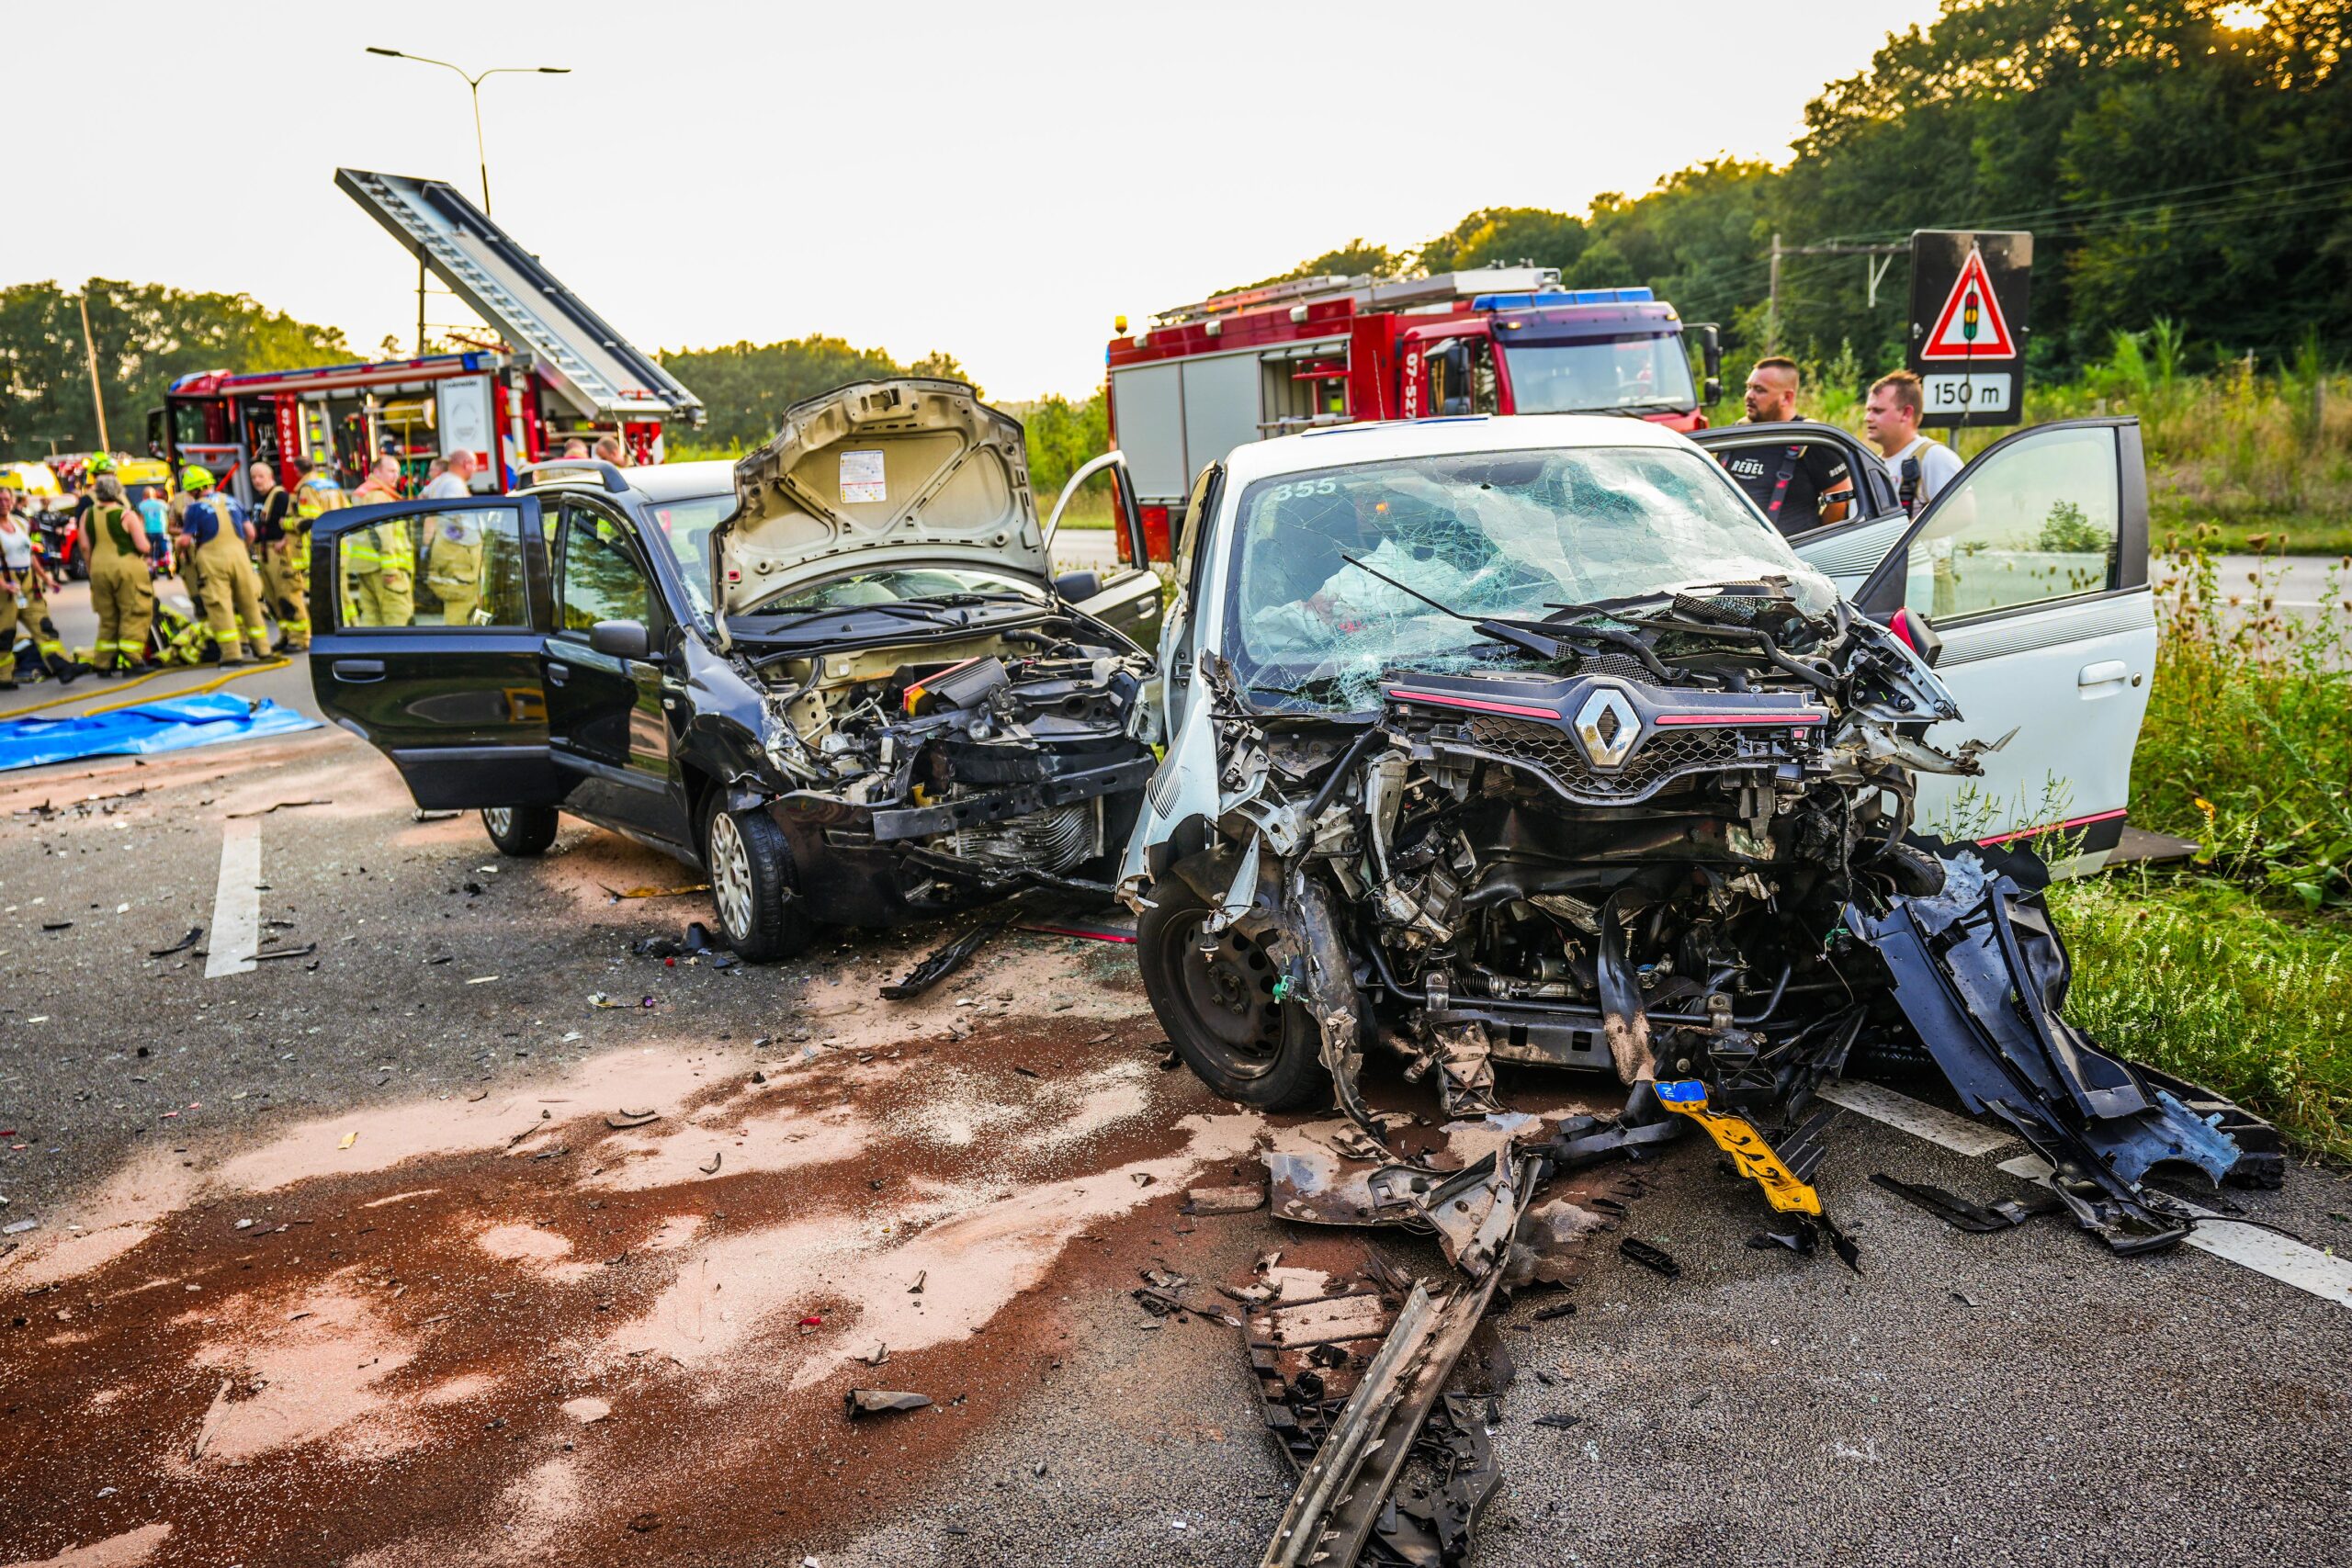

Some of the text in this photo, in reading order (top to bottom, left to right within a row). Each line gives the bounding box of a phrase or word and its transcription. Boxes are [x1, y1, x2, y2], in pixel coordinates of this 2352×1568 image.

[1935, 382, 1999, 404] 150 m
[1731, 460, 1764, 475] REBEL
[1274, 478, 1336, 502] 355
[1662, 1087, 1675, 1100] NL
